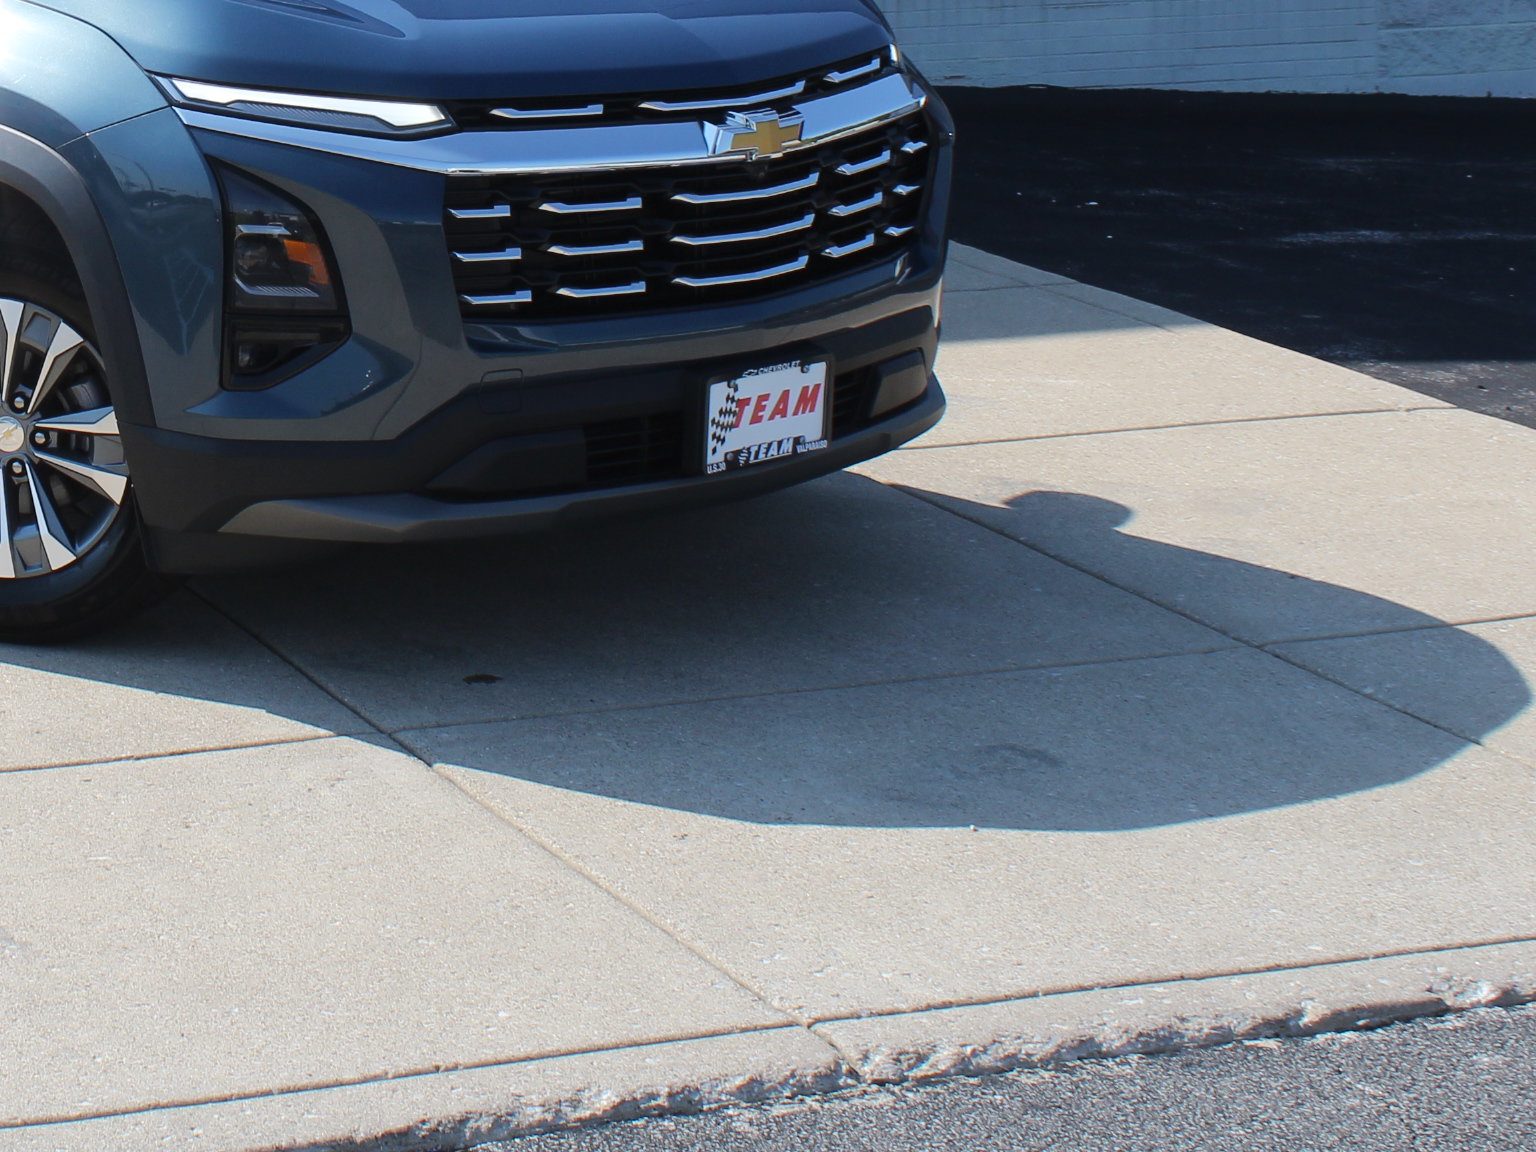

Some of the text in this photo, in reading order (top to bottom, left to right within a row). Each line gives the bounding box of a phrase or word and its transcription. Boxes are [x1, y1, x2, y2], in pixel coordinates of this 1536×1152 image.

[758, 360, 801, 375] CHEVROLET
[732, 383, 822, 429] TEAM
[749, 437, 793, 462] TEAM
